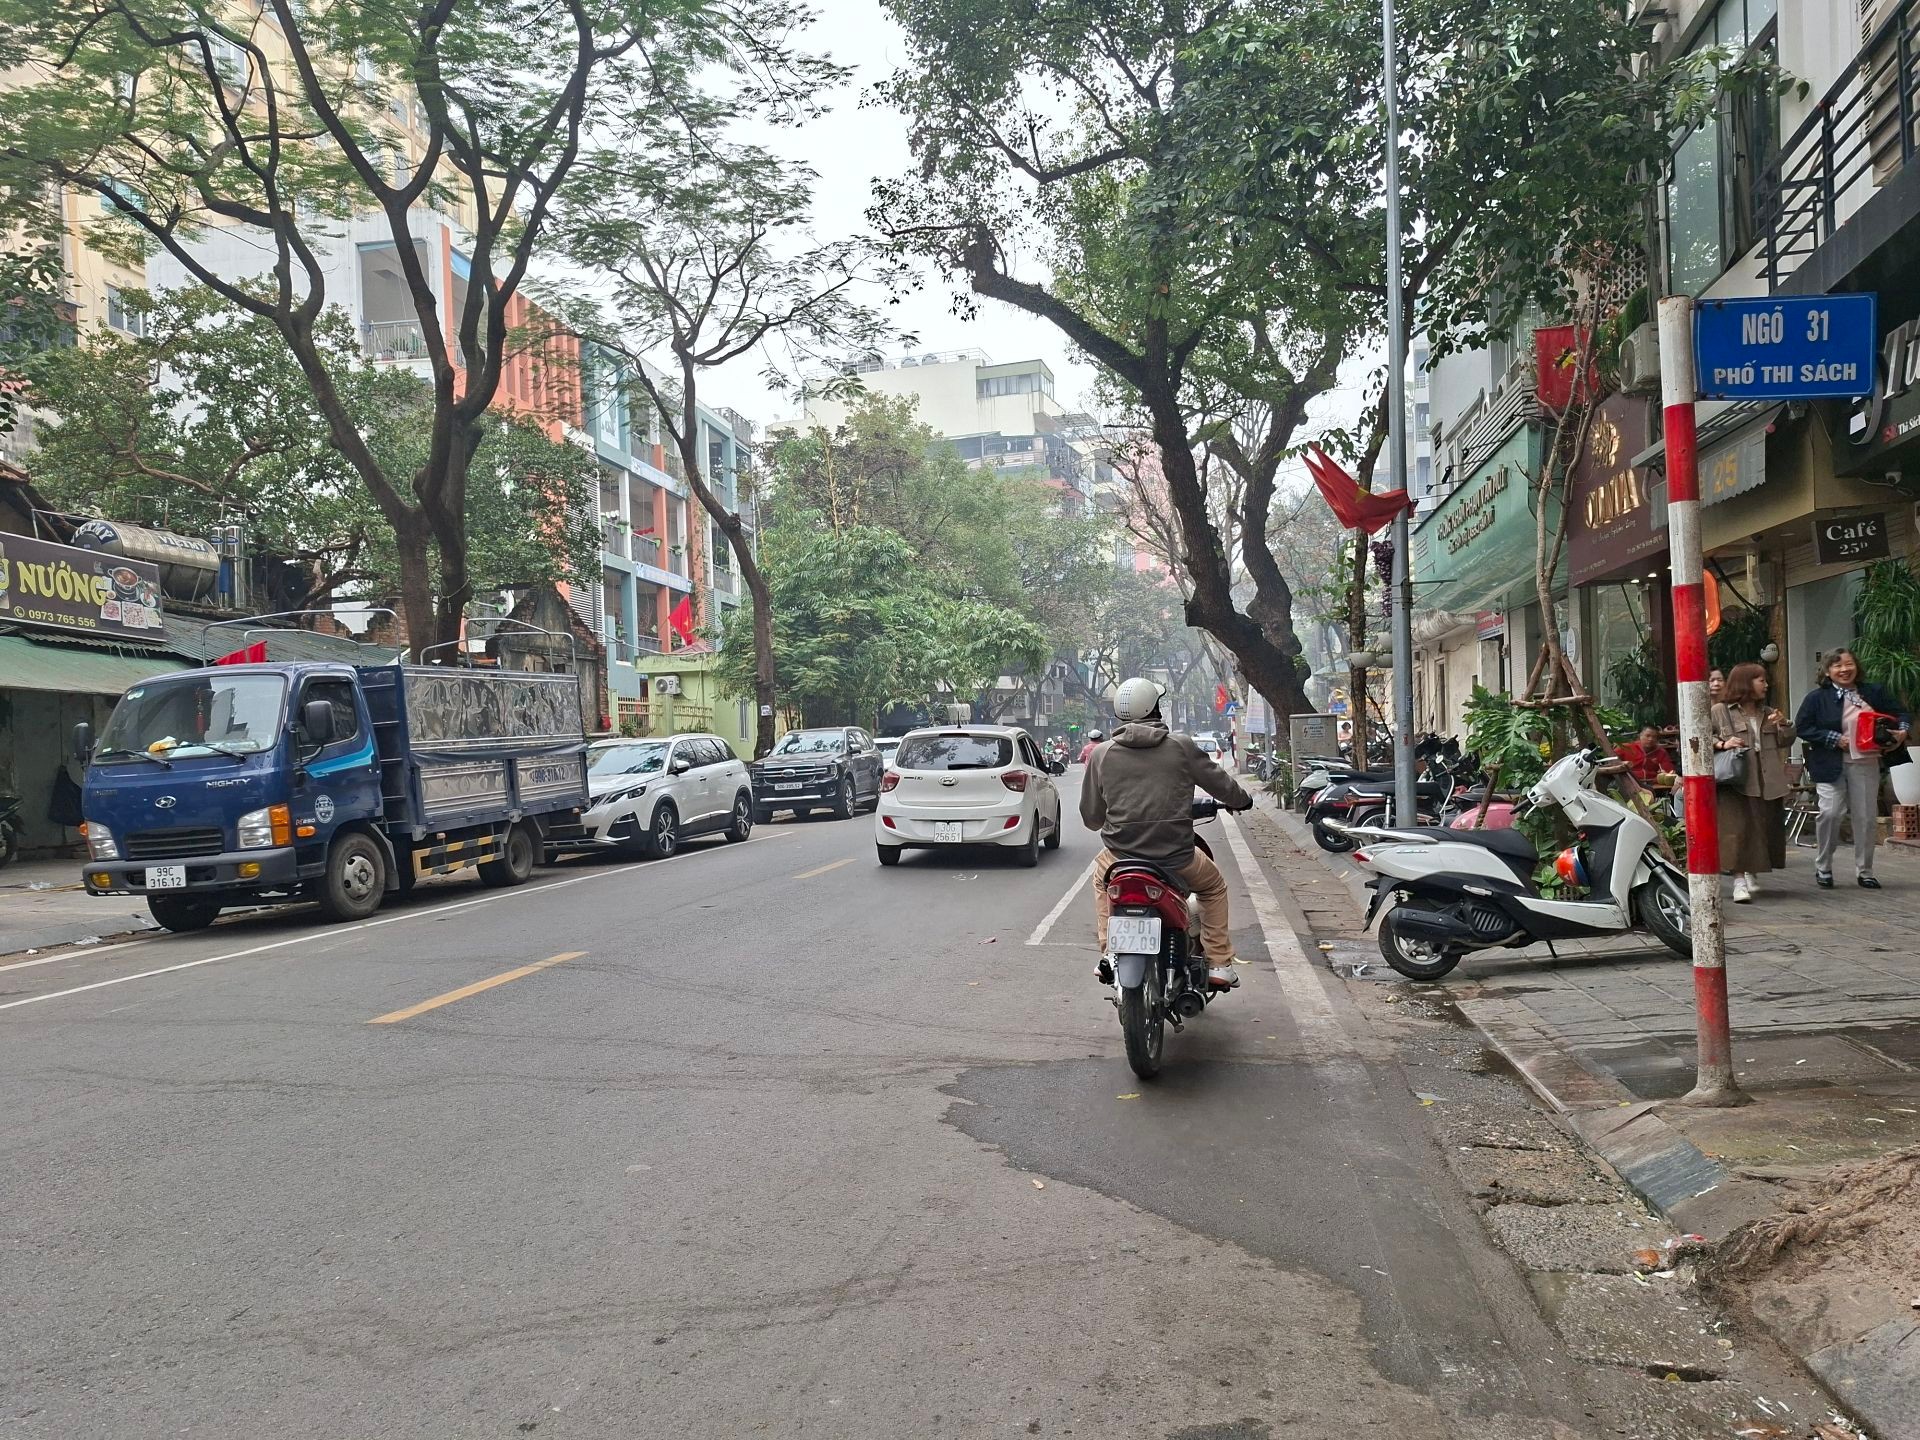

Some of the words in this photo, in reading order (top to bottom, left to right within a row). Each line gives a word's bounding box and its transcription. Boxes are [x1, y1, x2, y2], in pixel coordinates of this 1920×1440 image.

[1742, 306, 1784, 345] NGÕ
[1807, 310, 1829, 342] 31
[1714, 360, 1756, 385] PHỐ
[1761, 365, 1793, 384] THI
[1800, 358, 1857, 382] SÁCH
[1826, 520, 1877, 541] Café
[17, 560, 108, 607] NƯỚNG
[28, 609, 54, 622] 0973
[56, 613, 76, 625] 765
[77, 616, 96, 628] 556
[156, 867, 174, 877] 99C
[150, 877, 182, 888] 316.12
[1110, 935, 1156, 951] 927.09
